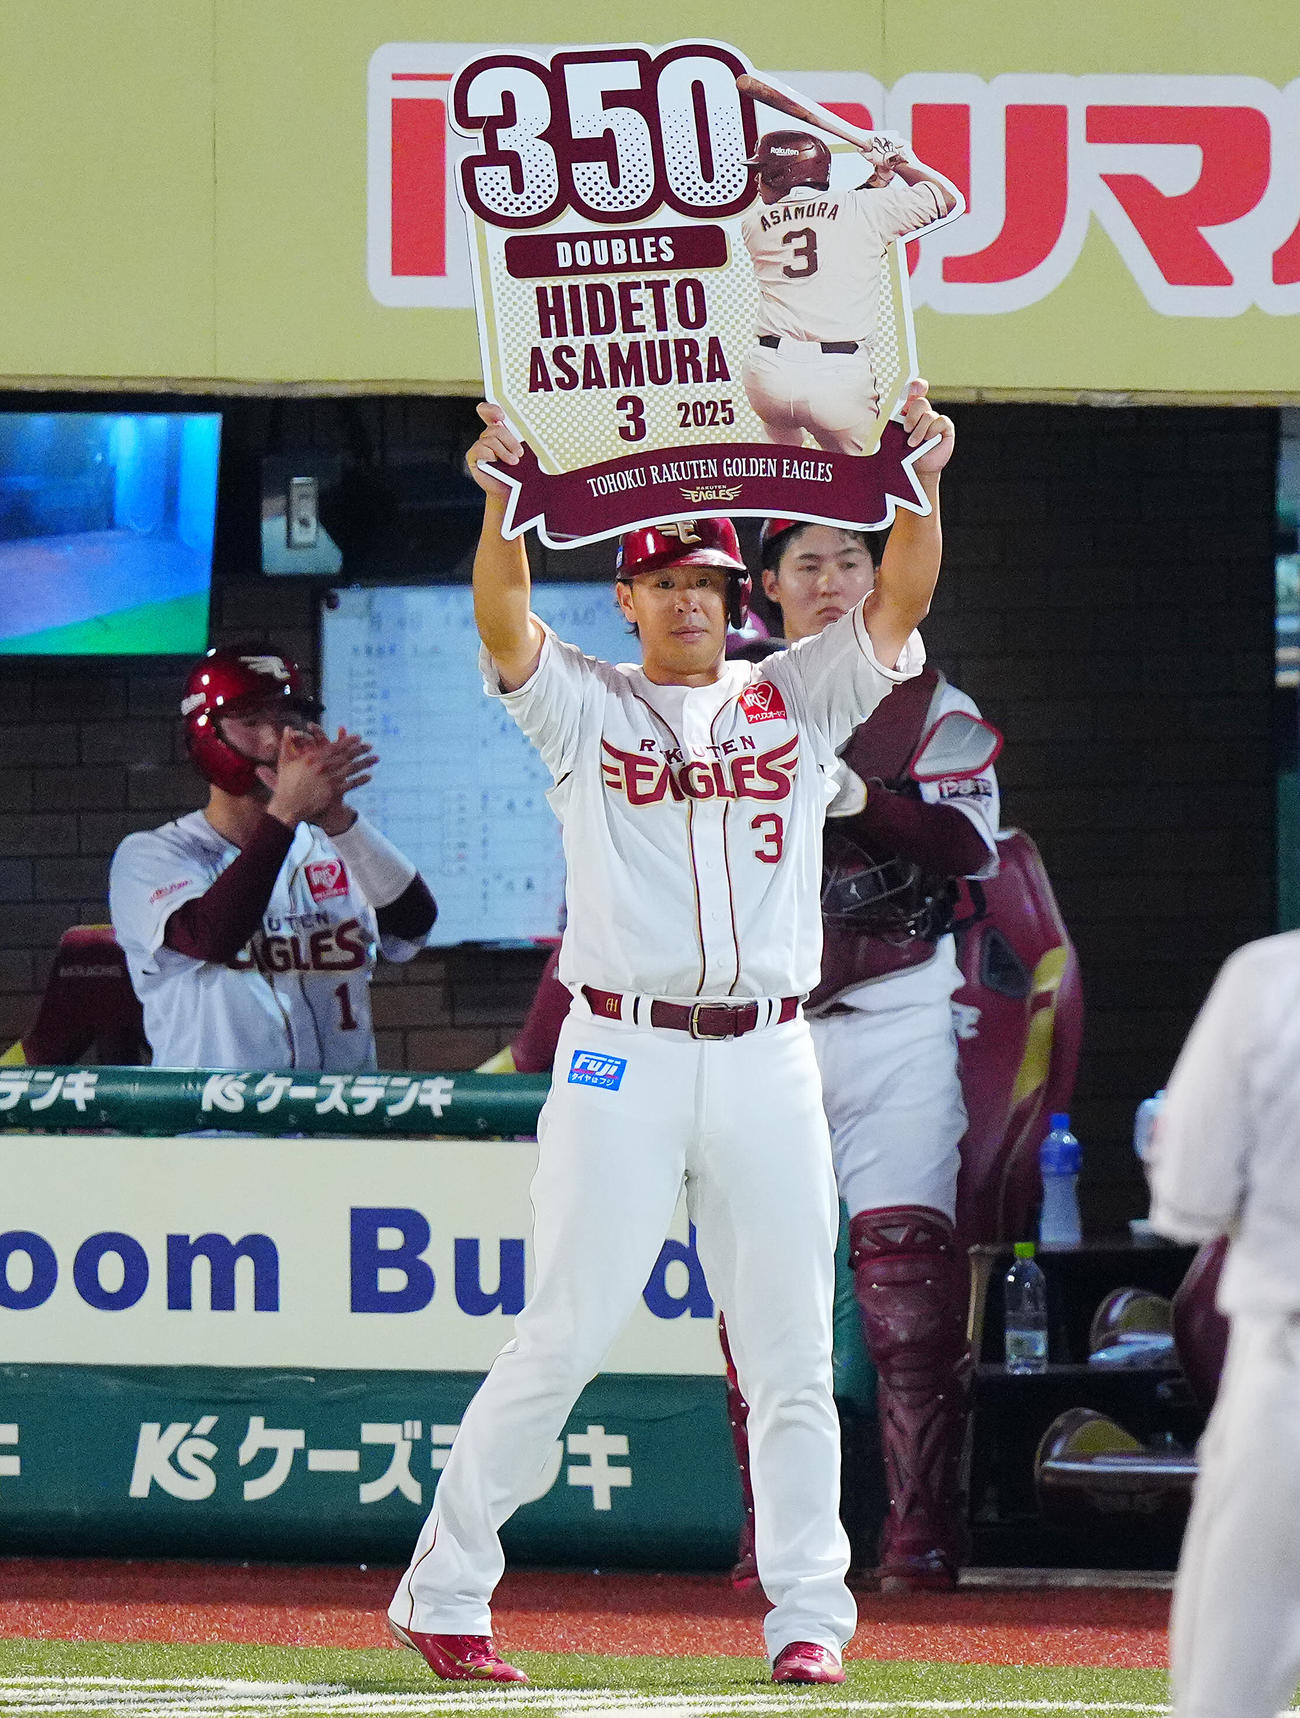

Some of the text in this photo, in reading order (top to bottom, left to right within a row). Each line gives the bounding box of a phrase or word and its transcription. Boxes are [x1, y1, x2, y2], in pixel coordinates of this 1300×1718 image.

[461, 50, 744, 223] 350
[760, 201, 839, 232] ASAMURA
[556, 236, 675, 267] DOUBLES
[783, 227, 818, 278] 3
[535, 278, 708, 339] HIDETO
[528, 337, 731, 393] ASAMURA
[617, 396, 735, 442] 3 2025
[587, 458, 833, 497] TOHOKU RAKUTEN GOLDEN EAGLES
[684, 487, 740, 503] EAGLES
[743, 691, 768, 708] IRIS
[640, 736, 755, 765] RKUTEN
[610, 742, 795, 805] EAGLES
[751, 812, 783, 863] 3
[335, 982, 357, 1030] 1
[256, 1073, 454, 1117] ケーズデンキ
[570, 1072, 615, 1087] タイヤはフジ
